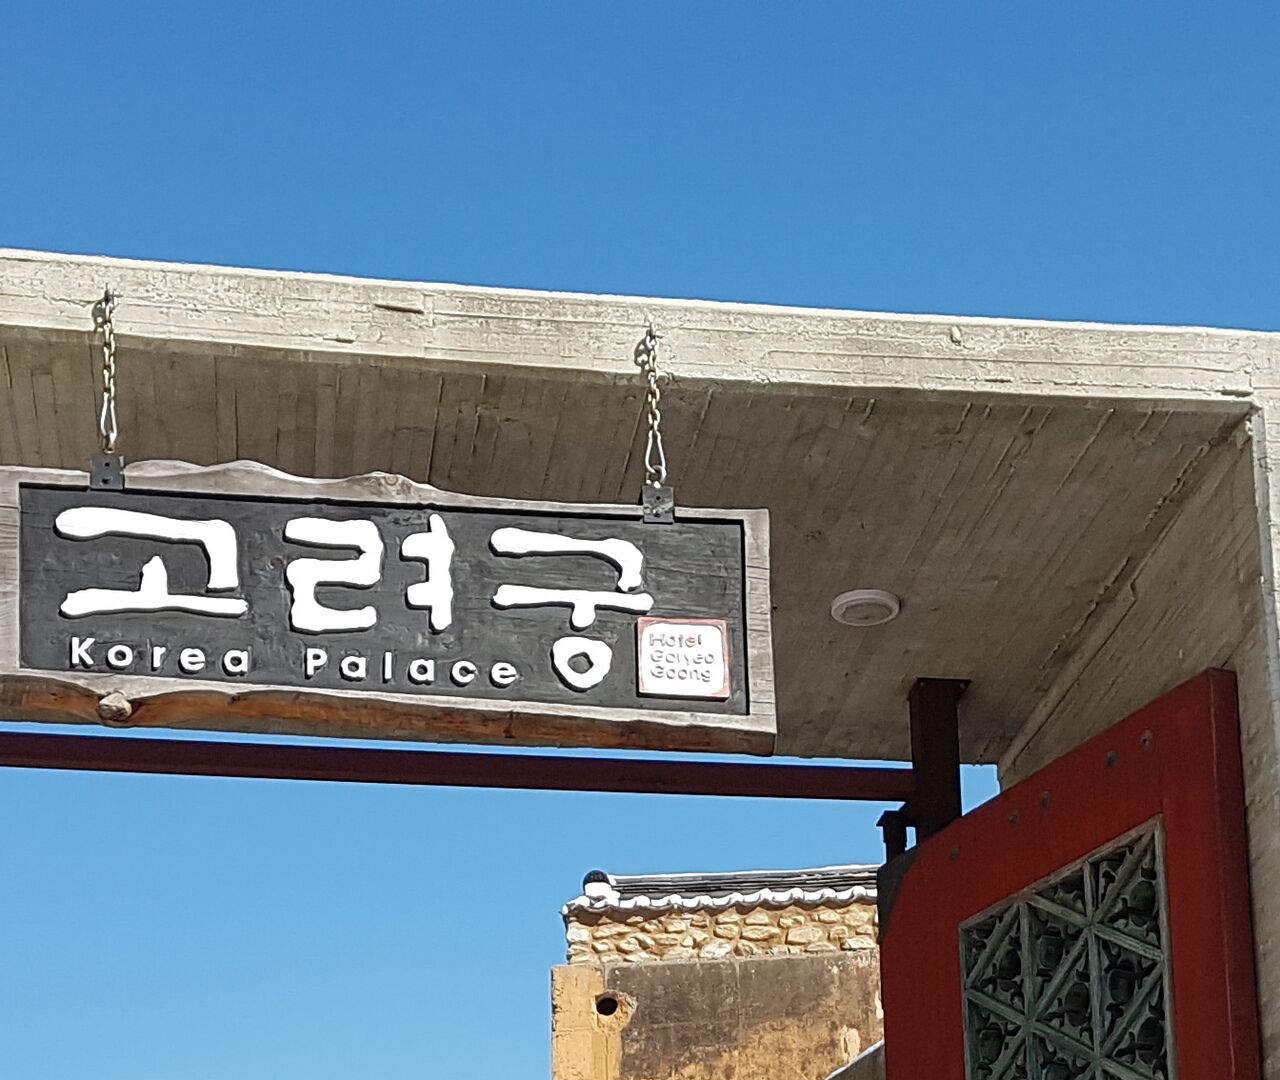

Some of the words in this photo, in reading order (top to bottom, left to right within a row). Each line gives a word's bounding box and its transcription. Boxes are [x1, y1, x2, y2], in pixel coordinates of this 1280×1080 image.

[54, 505, 654, 690] 고려궁
[649, 632, 702, 648] Hotel
[70, 636, 250, 677] Korea
[304, 647, 519, 686] Palace
[650, 665, 711, 683] Goong
